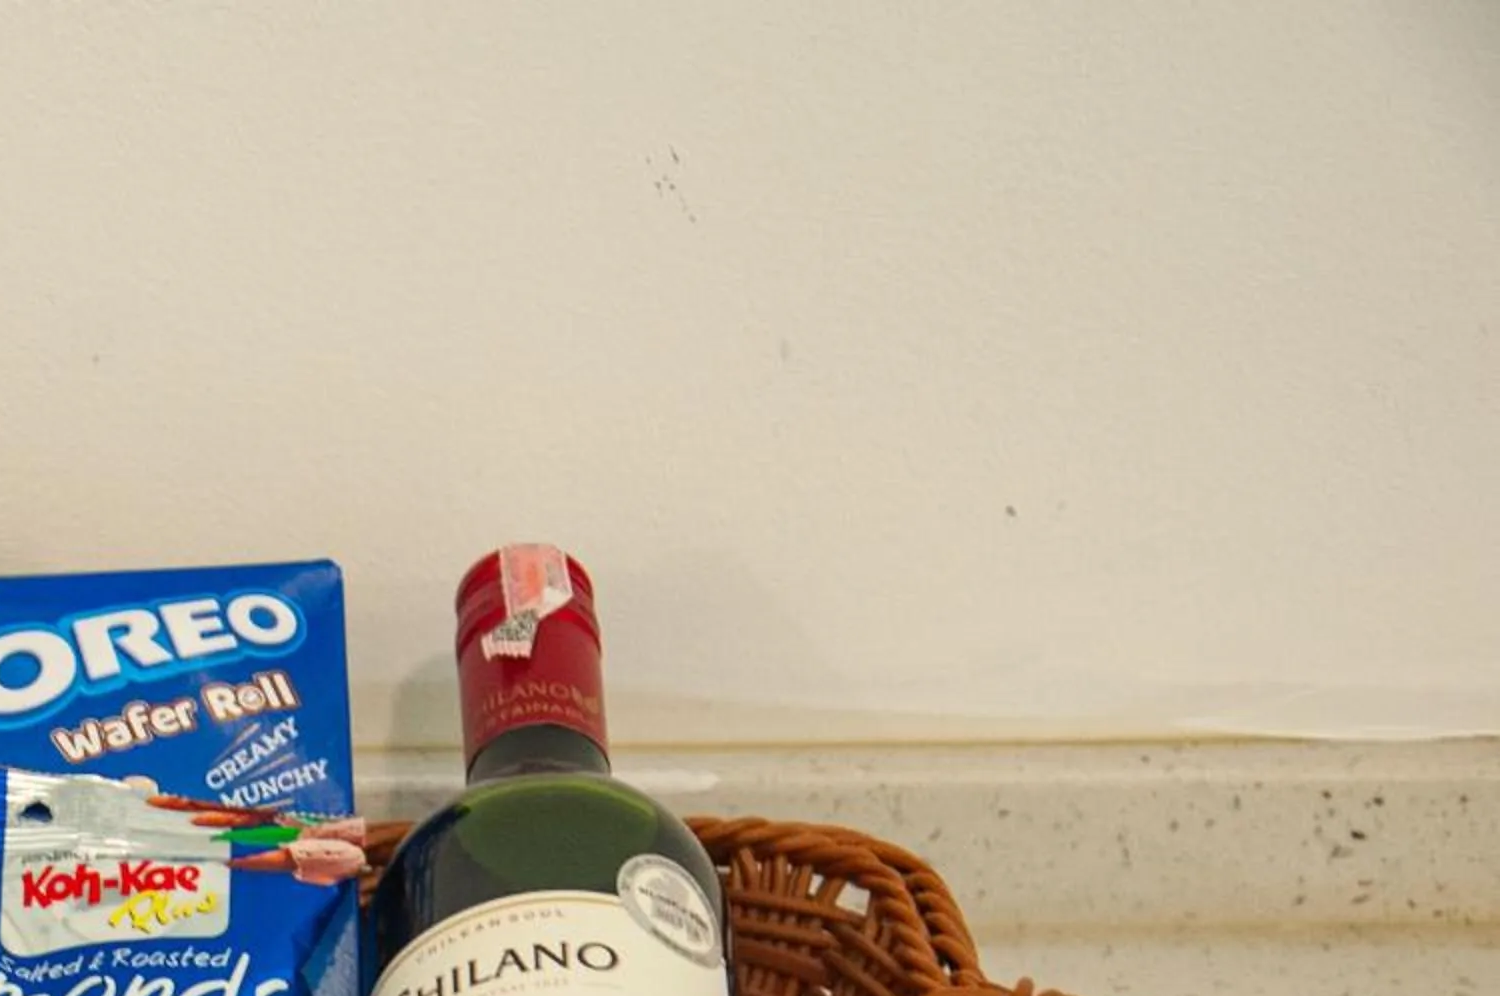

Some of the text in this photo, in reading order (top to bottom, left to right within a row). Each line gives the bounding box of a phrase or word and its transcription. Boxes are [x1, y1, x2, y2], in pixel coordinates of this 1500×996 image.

[52, 670, 299, 764] Wafer Roll
[205, 717, 301, 791] CREAMY
[221, 758, 330, 809] MUNCHY
[21, 859, 200, 909] Koh-Kae
[0, 953, 83, 984] Salted
[111, 945, 233, 969] Roasted
